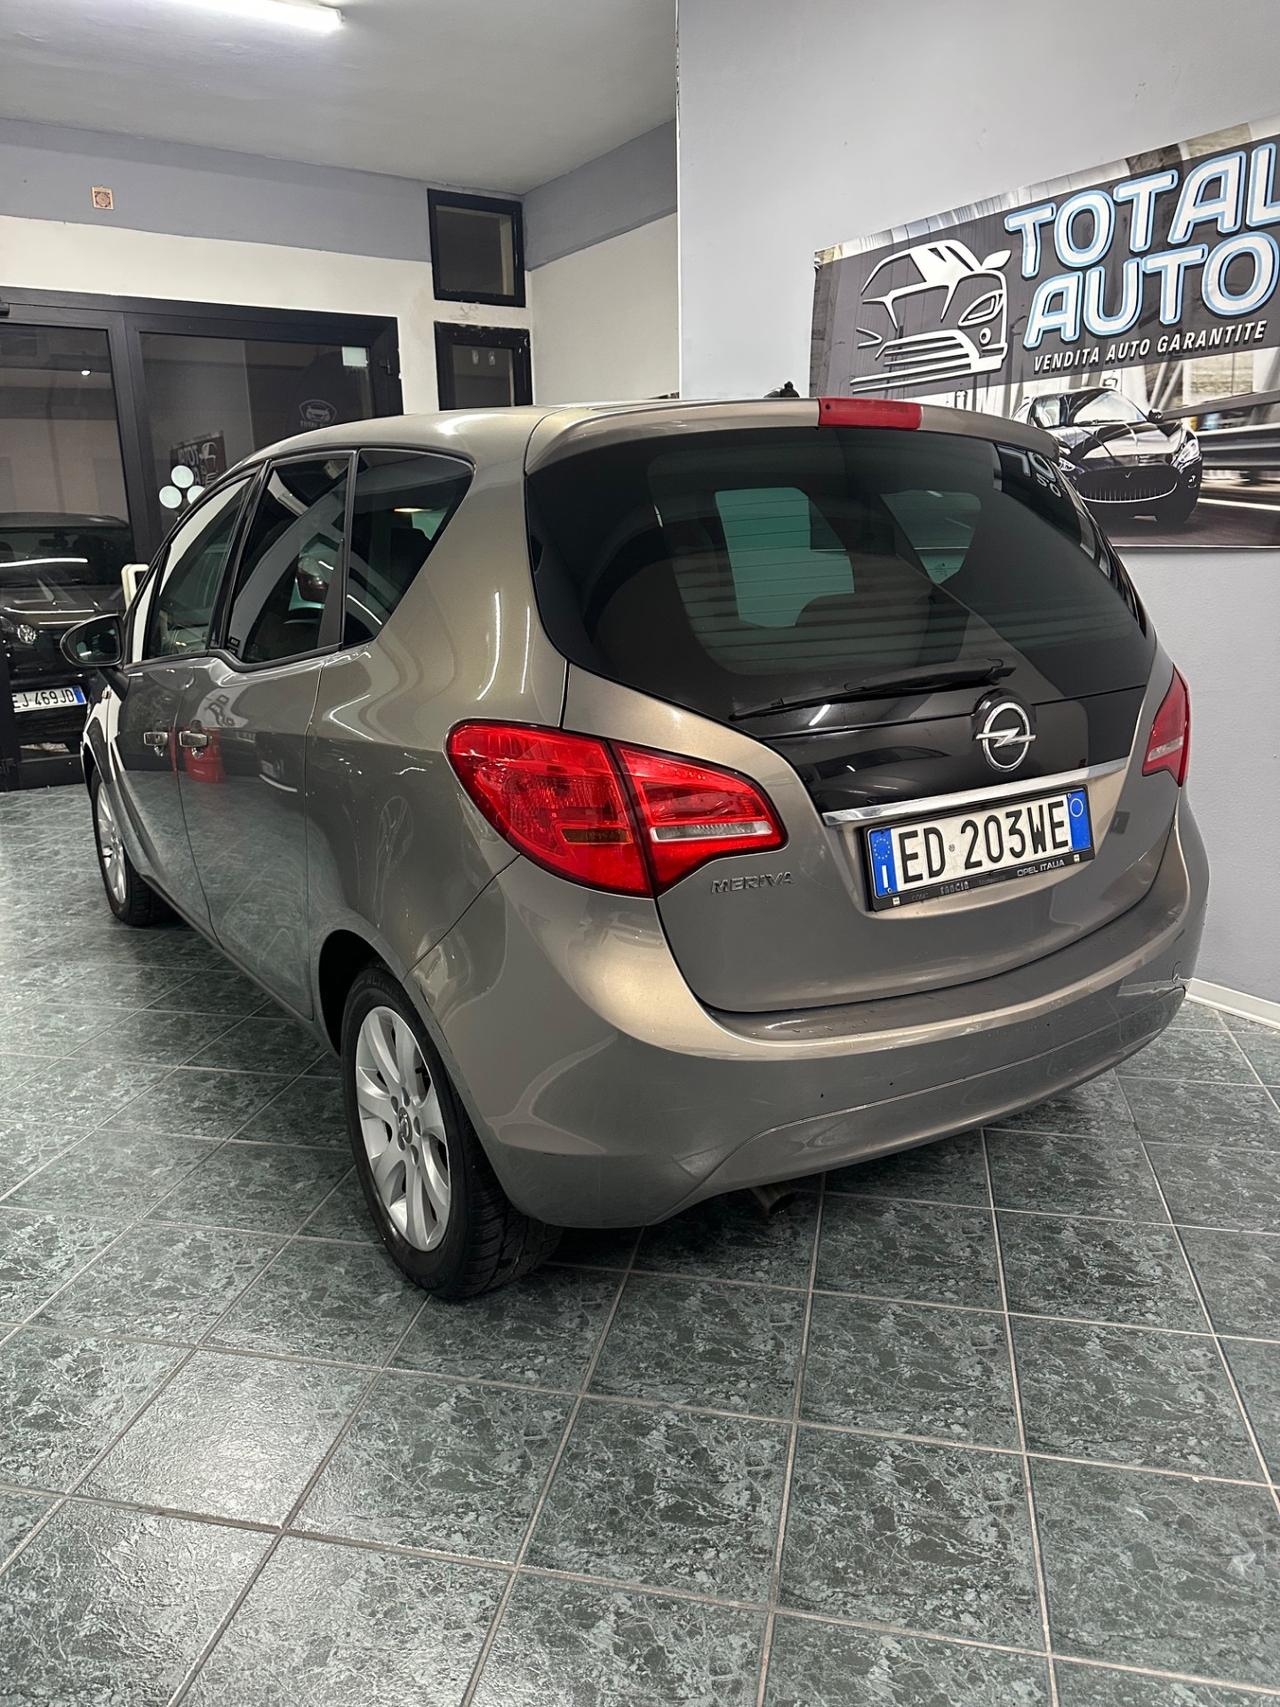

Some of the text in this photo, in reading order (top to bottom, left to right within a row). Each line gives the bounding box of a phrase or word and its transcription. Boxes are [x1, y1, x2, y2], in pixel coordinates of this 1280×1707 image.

[1004, 143, 1280, 277] TOTAL
[1023, 231, 1279, 348] AUTO
[1034, 320, 1267, 373] VENDITA AUTO GARANTITE
[898, 800, 1069, 884] ED 203WE
[1016, 859, 1065, 877] OPEL ITALIA
[711, 871, 793, 894] MERIVA
